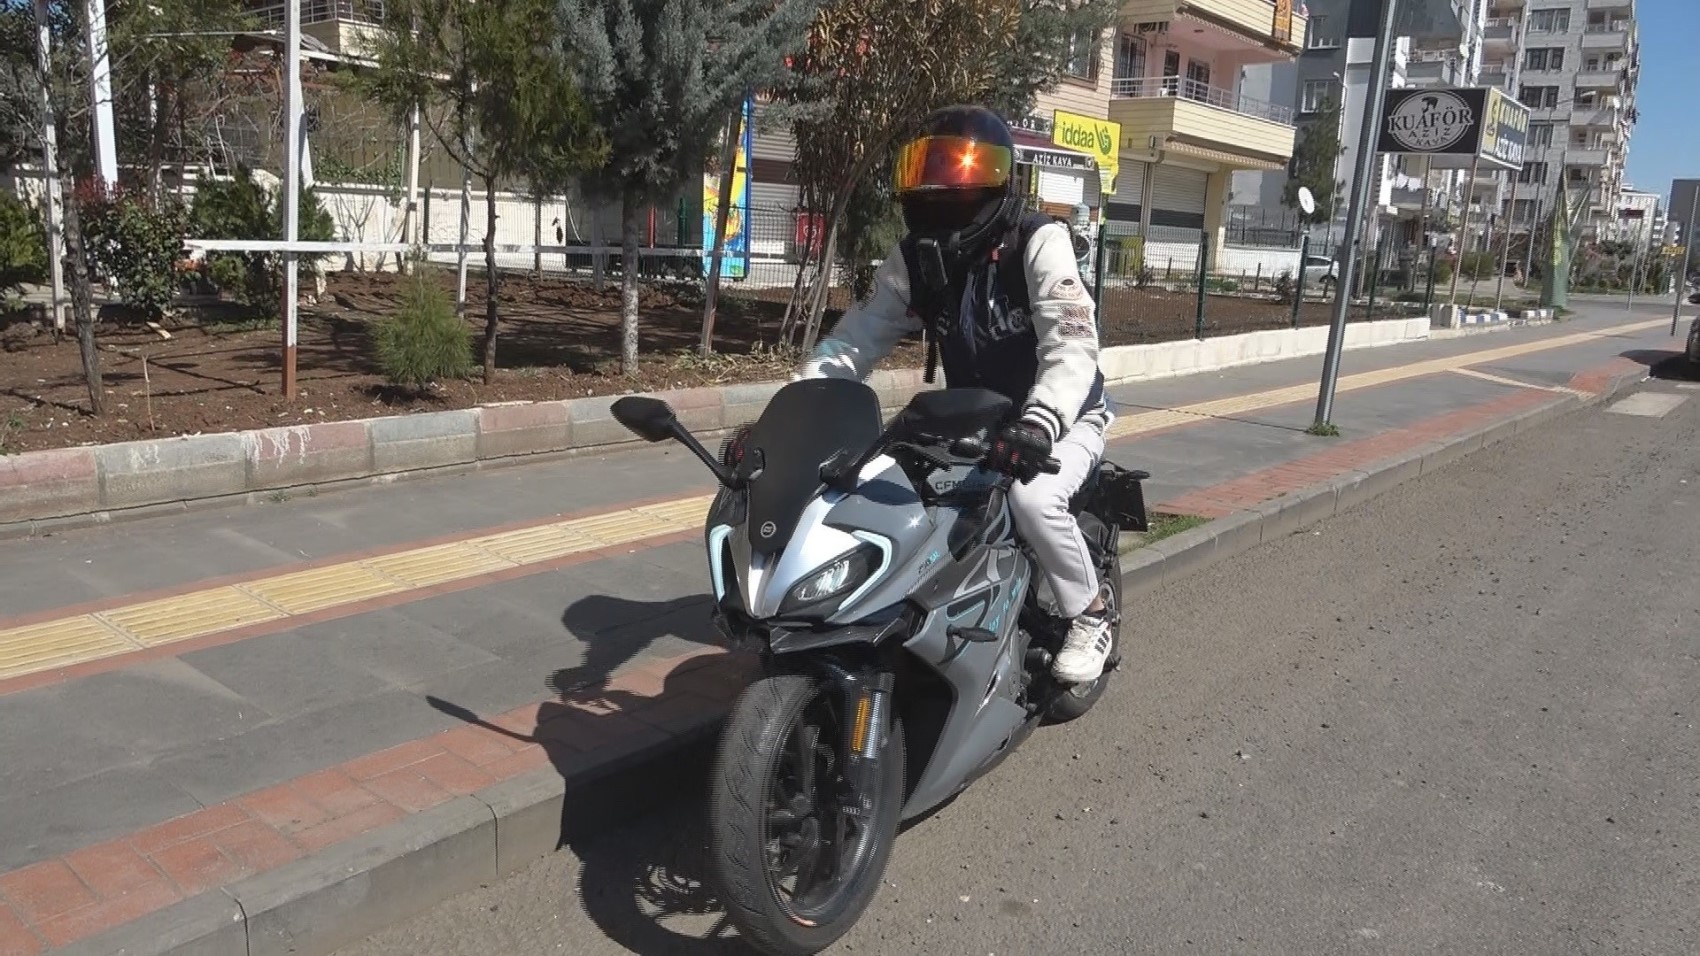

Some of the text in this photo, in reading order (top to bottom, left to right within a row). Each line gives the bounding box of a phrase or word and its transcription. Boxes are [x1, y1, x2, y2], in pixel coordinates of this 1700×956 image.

[1390, 106, 1472, 131] KUAFÖR
[1062, 121, 1094, 148] iddaa
[1052, 156, 1073, 168] KAYA
